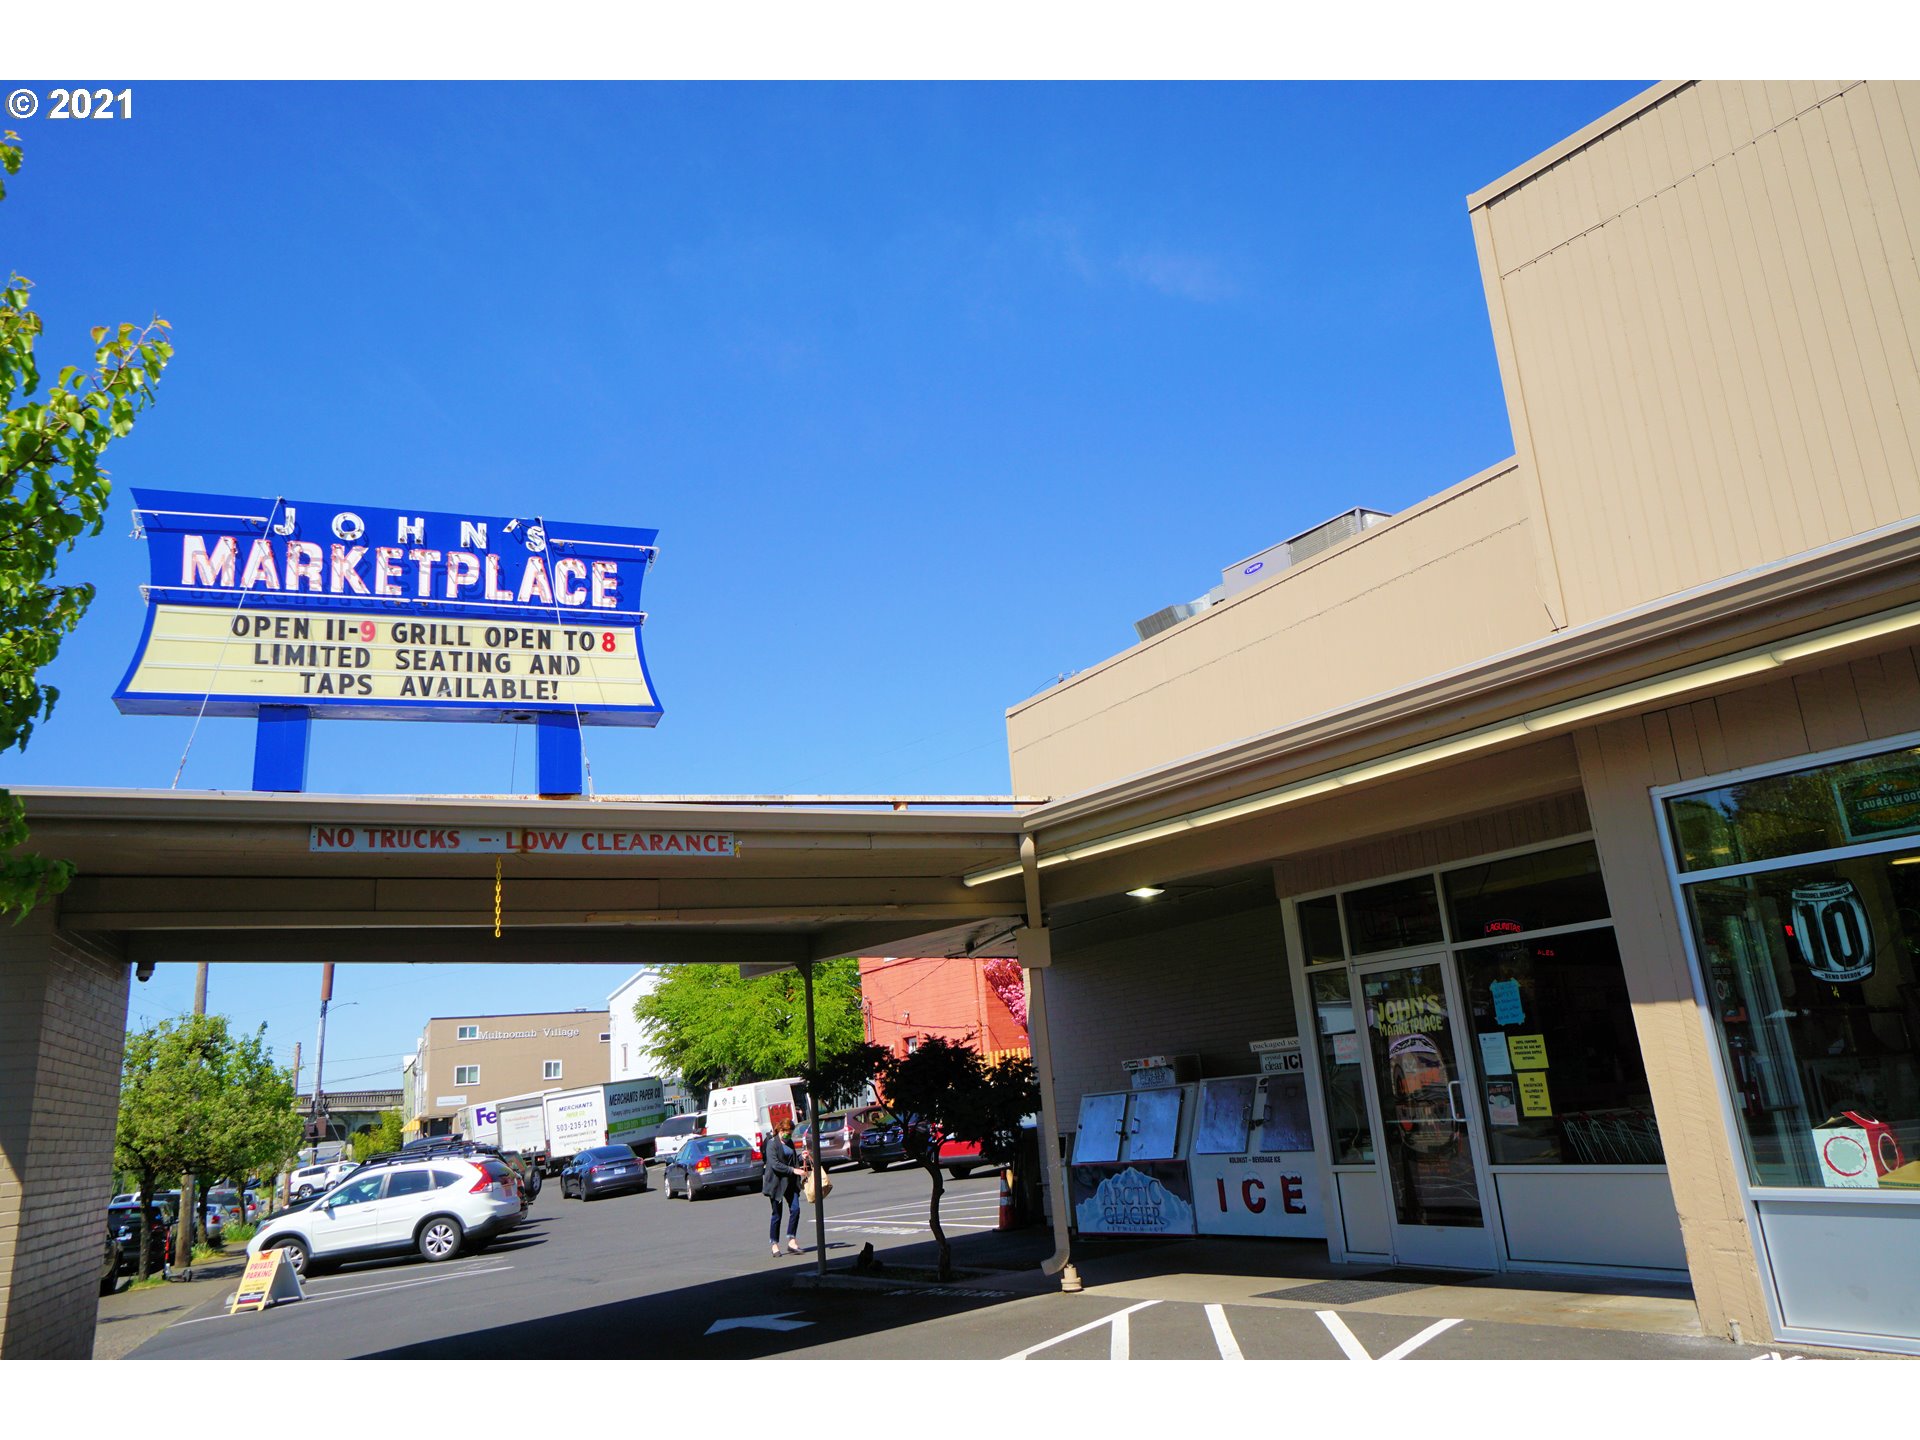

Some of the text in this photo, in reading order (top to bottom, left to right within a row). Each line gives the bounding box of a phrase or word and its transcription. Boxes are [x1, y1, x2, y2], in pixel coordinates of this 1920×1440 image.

[273, 507, 547, 552] JOHN'S
[182, 535, 618, 608] MARKETPLACE
[232, 615, 309, 639] OPEN
[391, 622, 470, 646] GRILL
[485, 627, 551, 649] OPEN
[564, 631, 595, 651] TO
[602, 632, 616, 652] 8
[254, 643, 580, 675] LIMITED SEATING AND
[300, 672, 559, 700] TAPS AVAILABLE!
[317, 828, 355, 848] NO
[363, 829, 461, 849] TRUCKS
[506, 831, 569, 850] LOW
[581, 832, 730, 852] CLEARANCE
[1486, 922, 1521, 933] LAGUNITAS
[1798, 901, 1864, 968] 10
[1378, 994, 1441, 1022] JOHN'S
[479, 1028, 580, 1040] Multnomah Village
[1380, 1015, 1444, 1036] MARKETPLACE
[1253, 1040, 1286, 1050] packaged
[1265, 1061, 1283, 1070] clear
[559, 1101, 593, 1112] MERCHANTS
[609, 1090, 638, 1106] MERCHANTS
[640, 1088, 653, 1100] PAPER
[556, 1119, 598, 1132] 503-235-2171
[1102, 1180, 1161, 1206] ARCTIC
[1216, 1171, 1307, 1214] ICE
[1104, 1206, 1165, 1225] GLACIER
[246, 1270, 272, 1279] PARKING
[250, 1261, 273, 1270] PRIVATE
